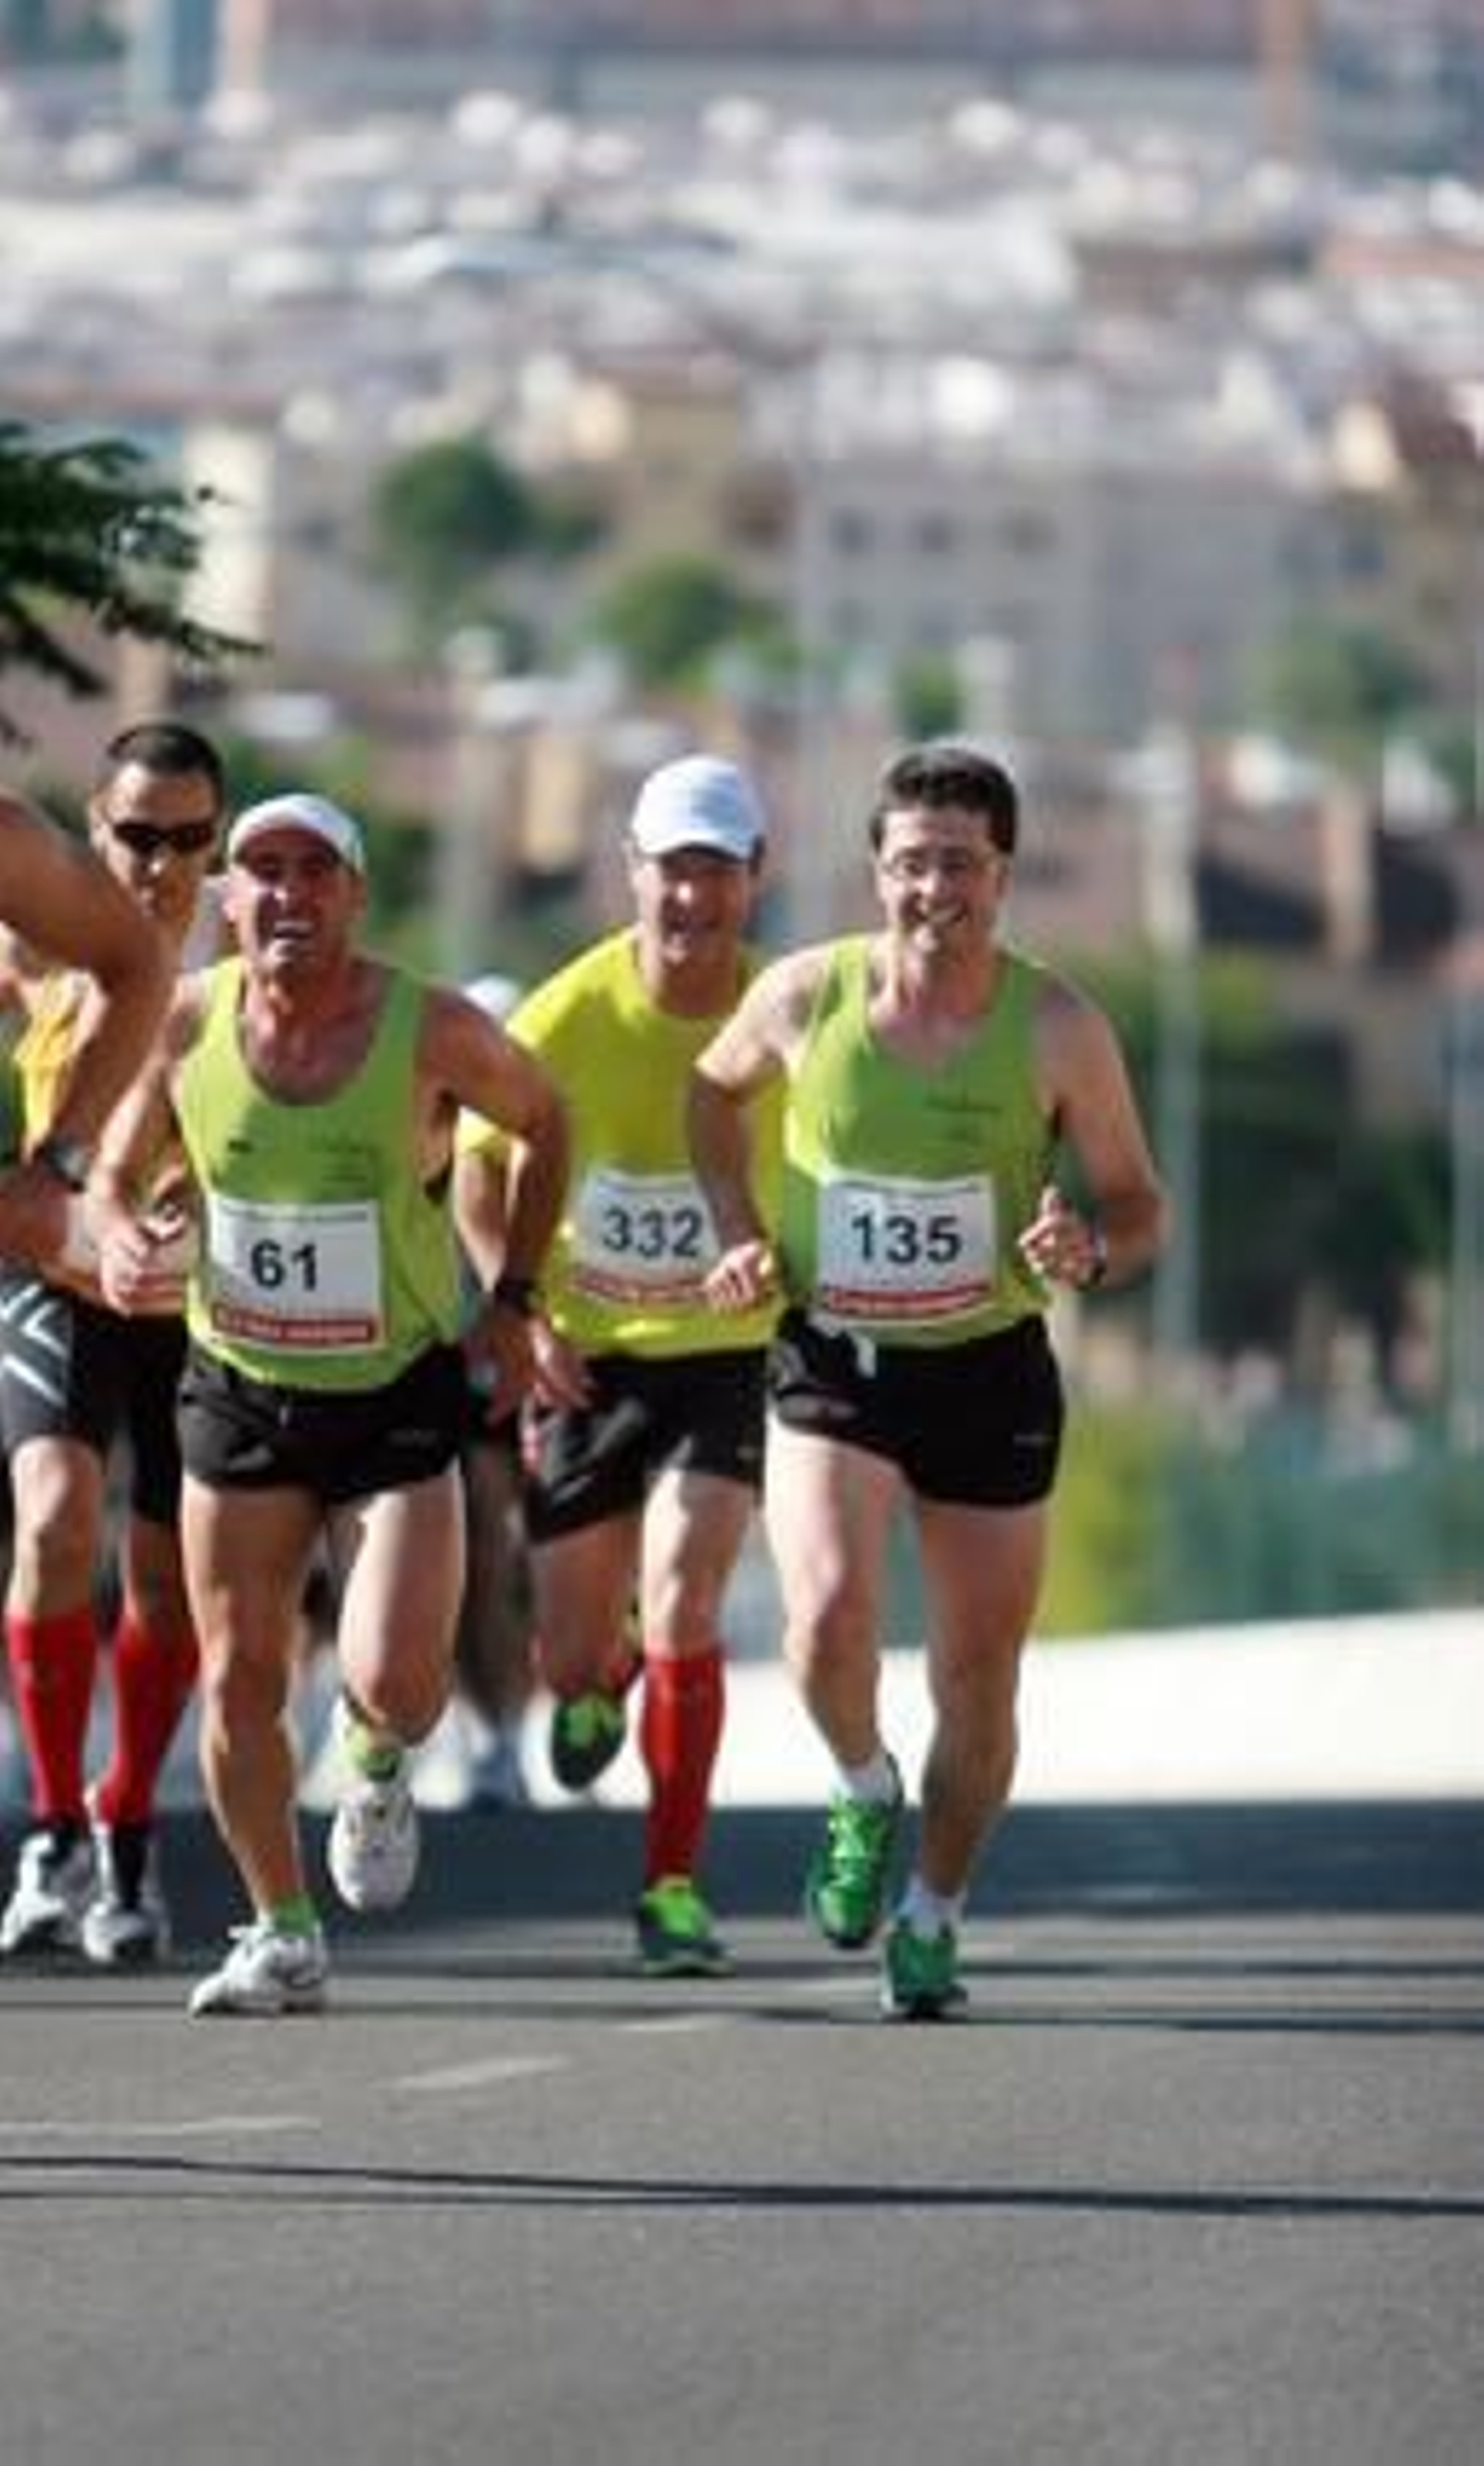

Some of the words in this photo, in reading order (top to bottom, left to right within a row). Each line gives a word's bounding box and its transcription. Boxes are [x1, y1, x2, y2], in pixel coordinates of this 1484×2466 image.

[602, 1207, 703, 1258] 332
[851, 1214, 962, 1265] 135
[250, 1239, 320, 1292] 61
